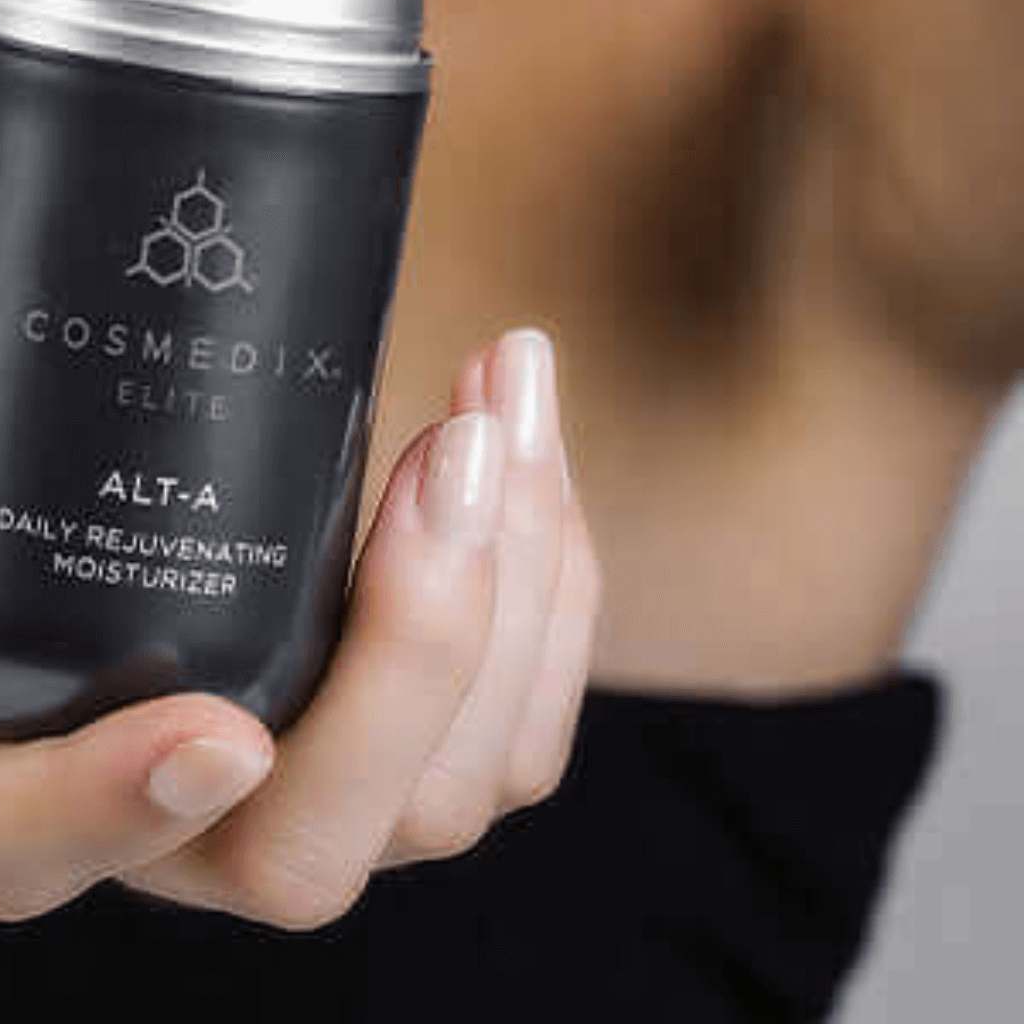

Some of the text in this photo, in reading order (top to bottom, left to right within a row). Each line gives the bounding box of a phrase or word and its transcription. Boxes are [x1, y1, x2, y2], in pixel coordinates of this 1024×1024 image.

[116, 380, 230, 422] ELITE
[98, 470, 220, 512] ALT-A
[87, 525, 288, 568] REJUVENATING
[53, 553, 237, 596] MOISTURIZER
